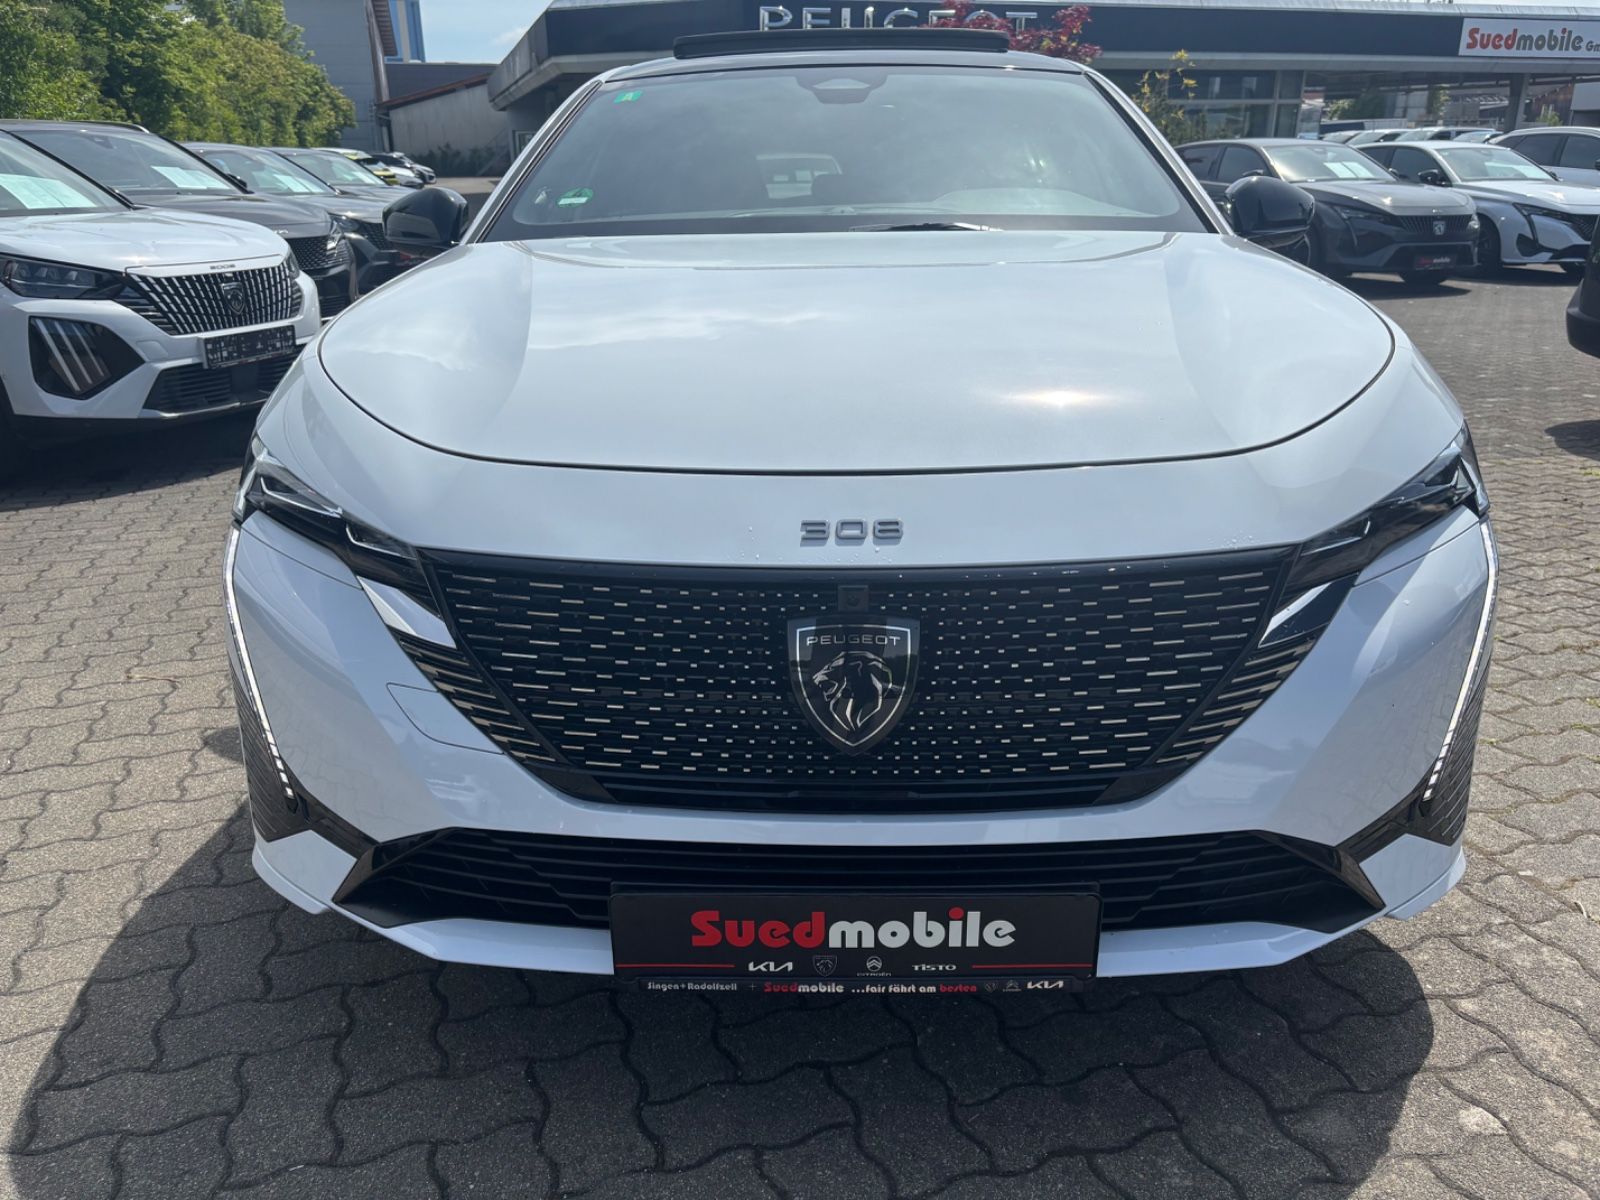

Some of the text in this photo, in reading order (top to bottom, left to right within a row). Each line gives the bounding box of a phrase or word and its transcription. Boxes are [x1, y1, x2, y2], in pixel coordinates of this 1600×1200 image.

[1466, 27, 1584, 52] Suedmobile
[799, 519, 904, 546] 308
[806, 634, 901, 646] PEUGEOT
[690, 907, 1016, 949] Suedmobile
[748, 961, 793, 972] KIA
[763, 981, 845, 993] Suedmobile
[888, 983, 916, 993] fährt
[919, 985, 937, 993] am
[940, 983, 977, 992] besten
